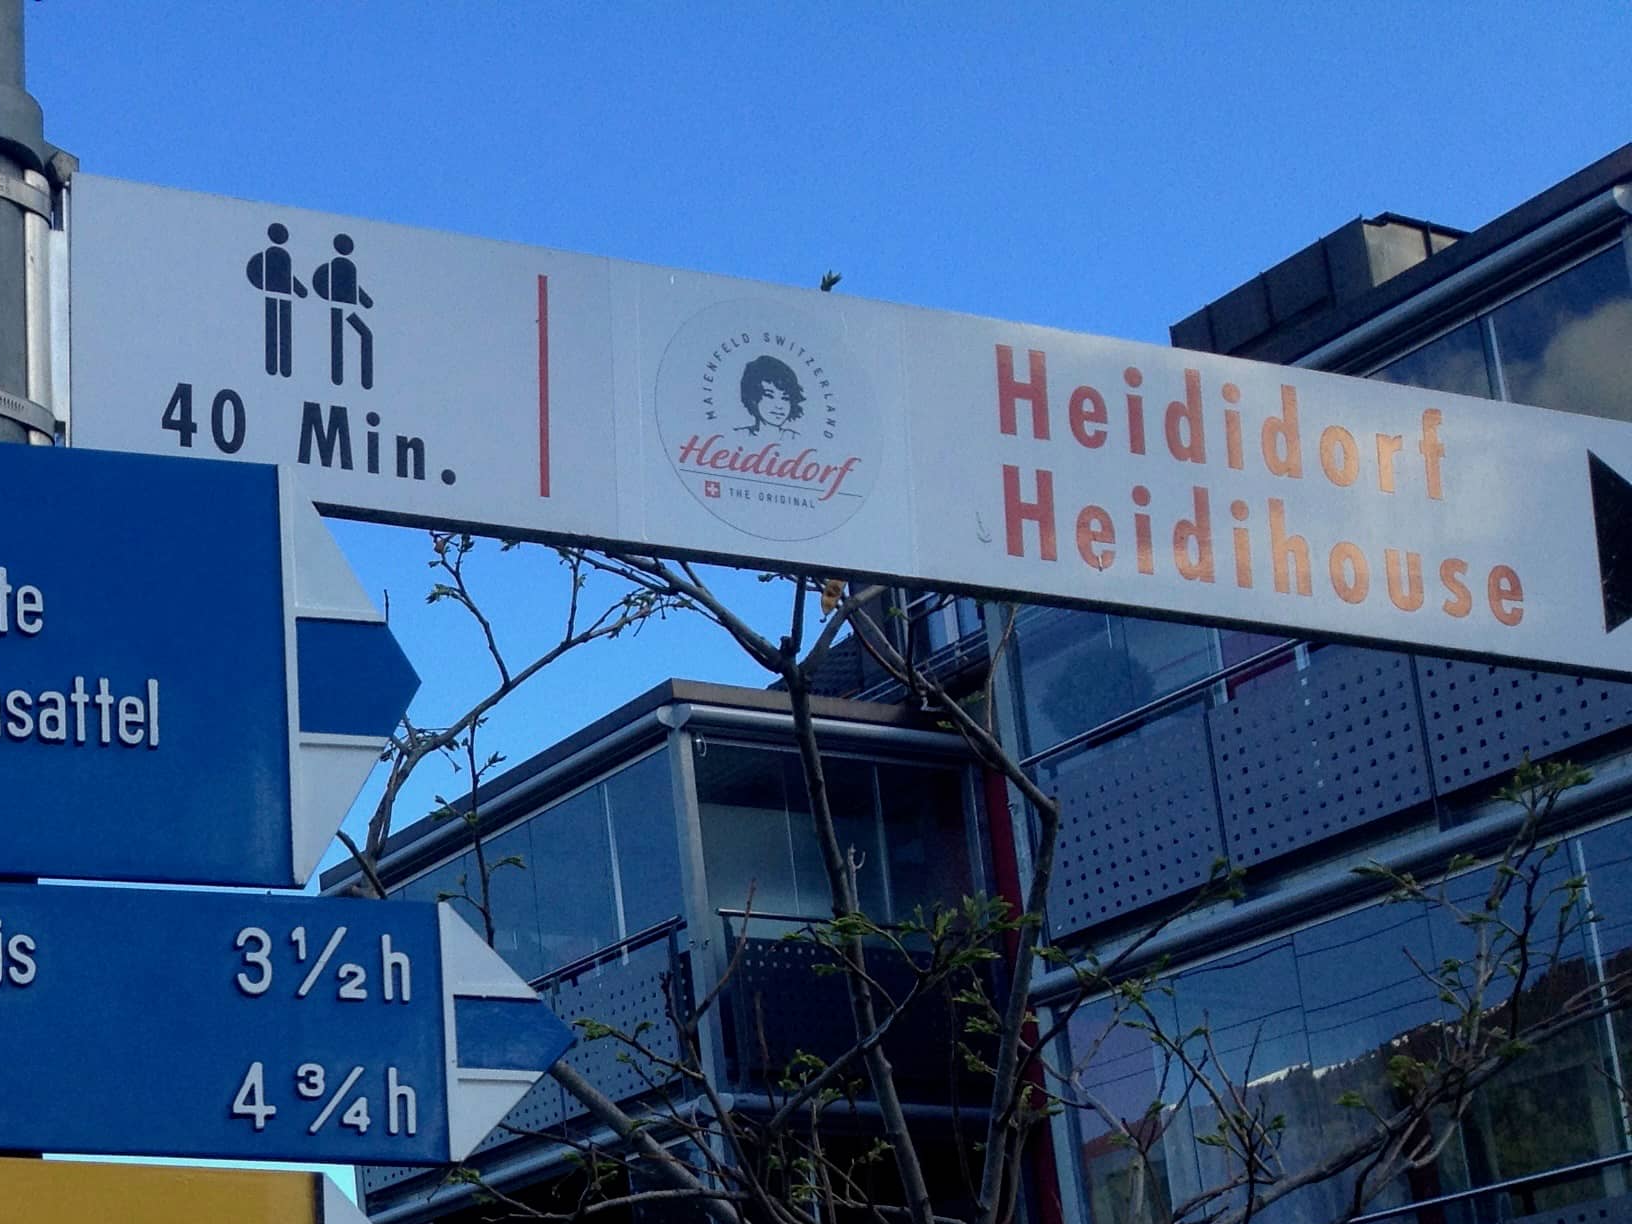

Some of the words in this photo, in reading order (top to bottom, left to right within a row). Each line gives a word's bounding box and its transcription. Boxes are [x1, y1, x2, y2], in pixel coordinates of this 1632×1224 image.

[702, 332, 752, 421] MAIENFELD
[762, 331, 837, 440] SWITZERLAND
[994, 343, 1446, 500] Heididorf
[161, 382, 247, 454] 40
[297, 401, 457, 486] Min.
[679, 434, 863, 501] Heididorf
[728, 487, 751, 500] THE
[758, 493, 816, 509] ORIGINAL
[1001, 463, 1525, 628] Heidihouse
[235, 926, 273, 997] 3
[231, 1061, 277, 1130] 4
